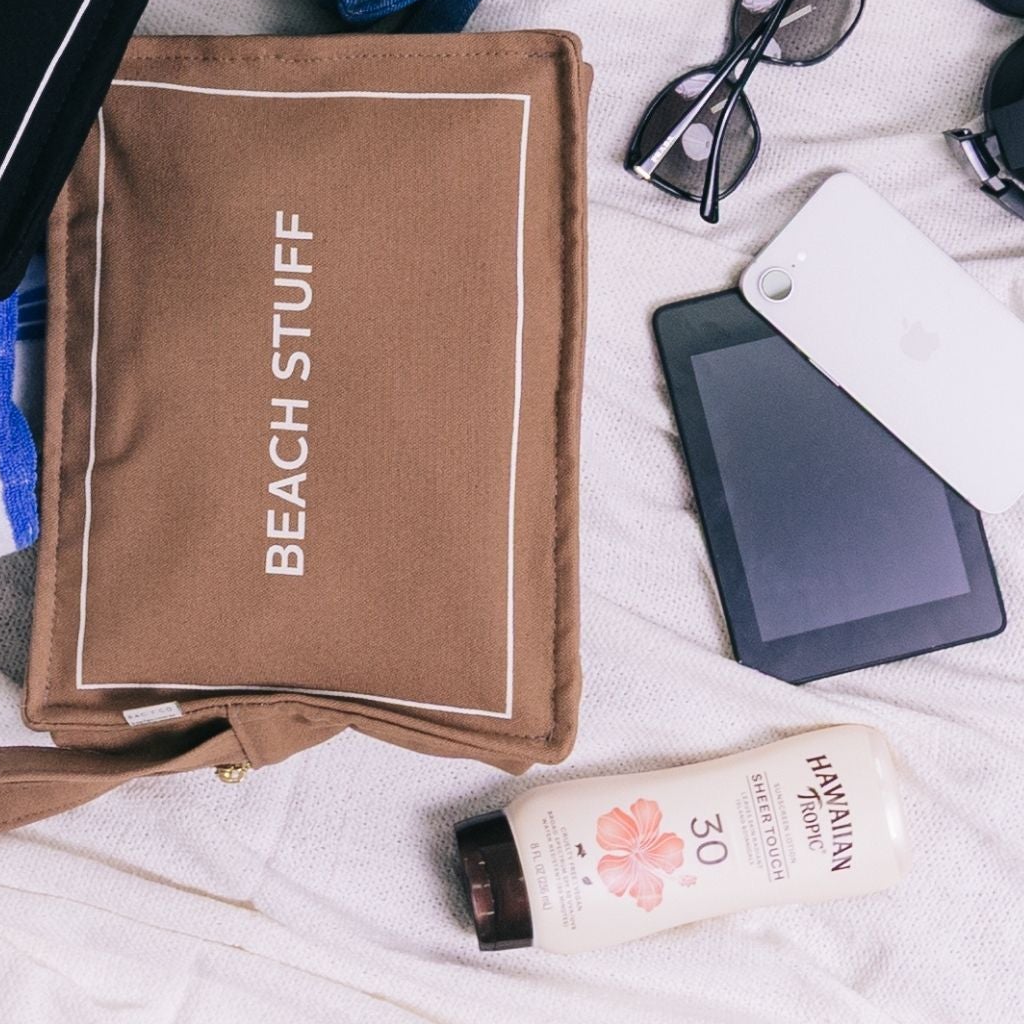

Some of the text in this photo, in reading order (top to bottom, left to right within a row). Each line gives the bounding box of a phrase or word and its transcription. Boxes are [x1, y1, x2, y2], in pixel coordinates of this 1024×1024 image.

[264, 210, 314, 577] BEACH STUFF
[690, 813, 729, 866] 30
[751, 774, 785, 881] SHEER TOUCH
[797, 785, 824, 852] TROPIC
[805, 754, 853, 872] HAWAIIAN
